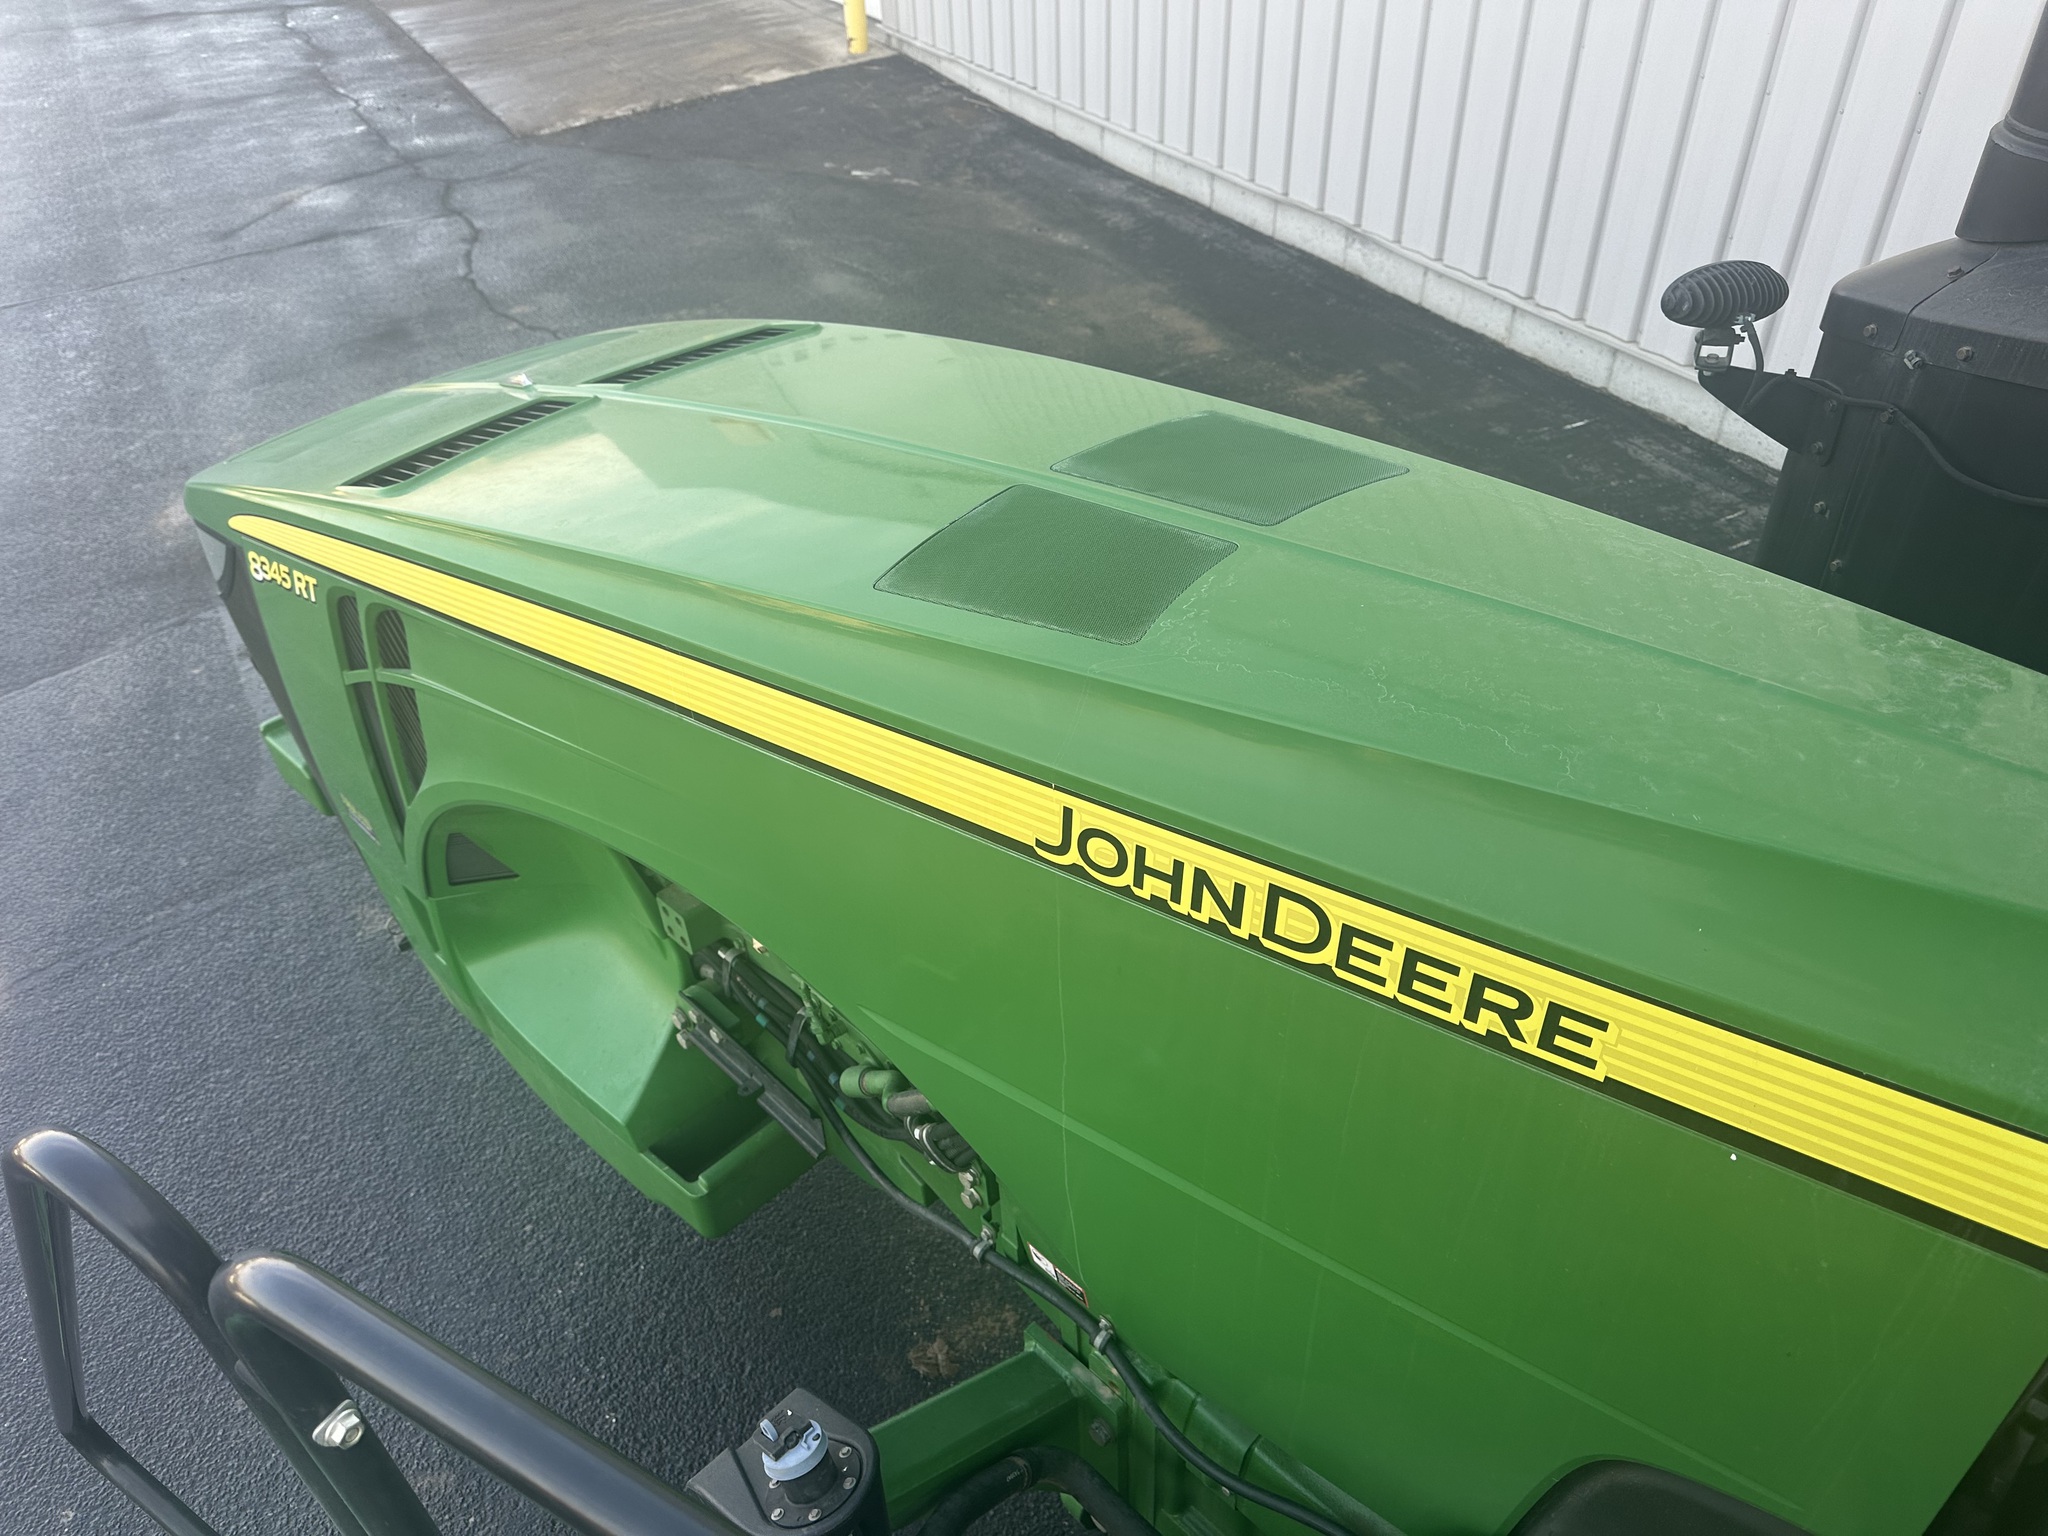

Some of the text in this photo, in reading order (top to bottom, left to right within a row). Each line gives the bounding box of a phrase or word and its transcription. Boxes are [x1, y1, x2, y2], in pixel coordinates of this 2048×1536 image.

[247, 550, 318, 603] 8345 RT
[1034, 804, 1611, 1073] JOHN DEERE
